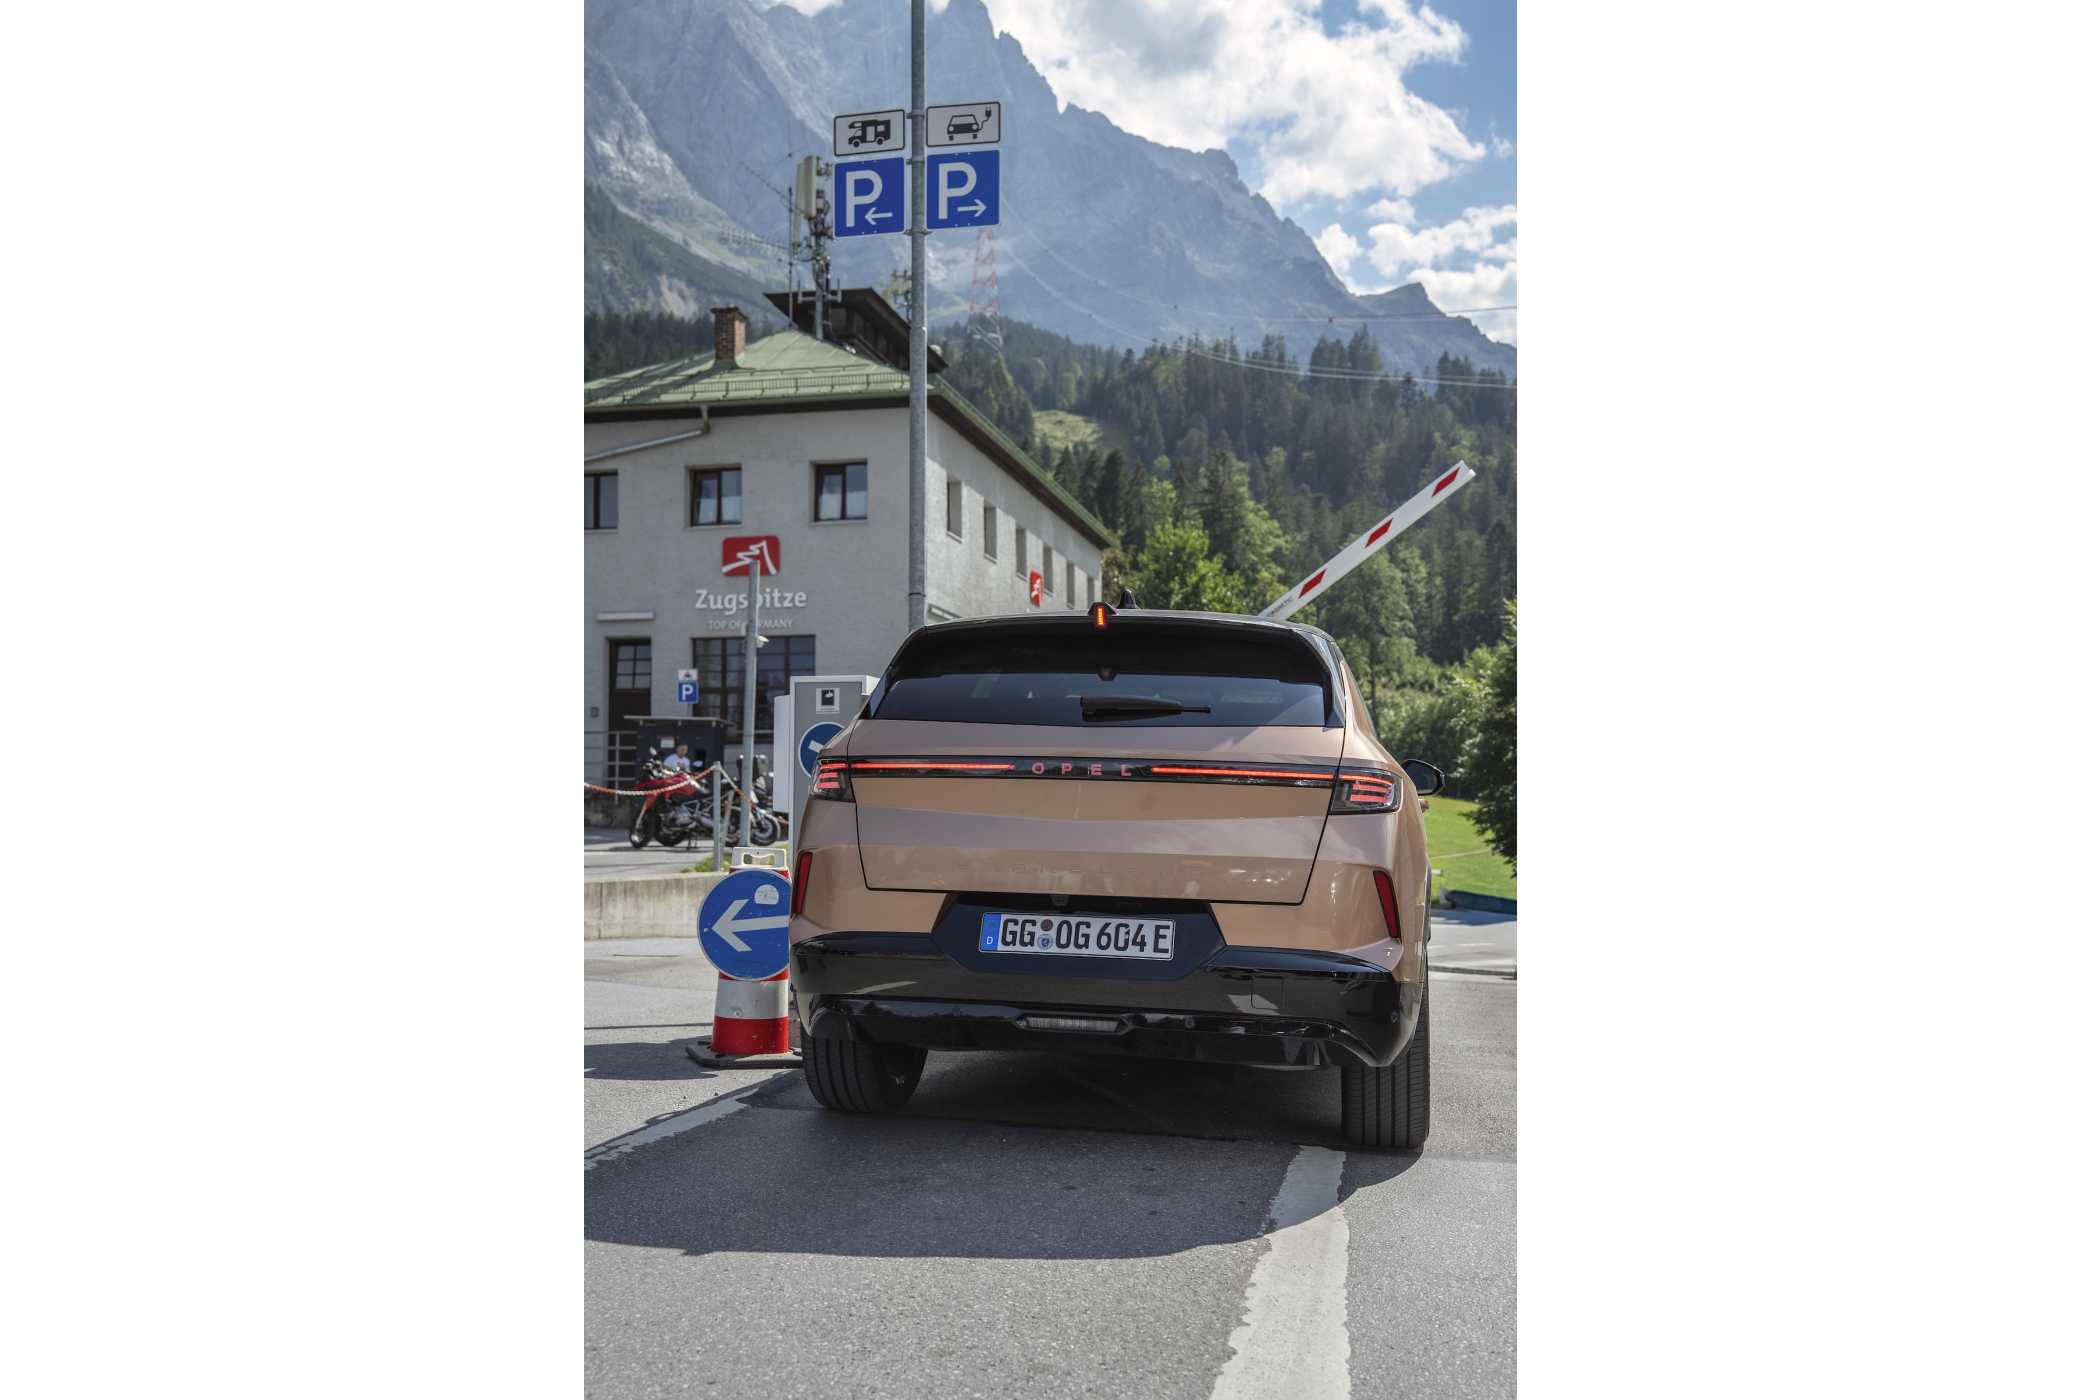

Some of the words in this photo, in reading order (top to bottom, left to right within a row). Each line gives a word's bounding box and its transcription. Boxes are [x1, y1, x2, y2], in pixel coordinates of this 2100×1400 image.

[846, 170, 883, 227] P
[938, 162, 977, 220] P
[708, 620, 725, 630] TOP
[682, 684, 694, 701] P
[1031, 762, 1132, 777] OPEL
[986, 936, 994, 945] D
[1001, 918, 1037, 947] GG
[1055, 919, 1092, 950] OG
